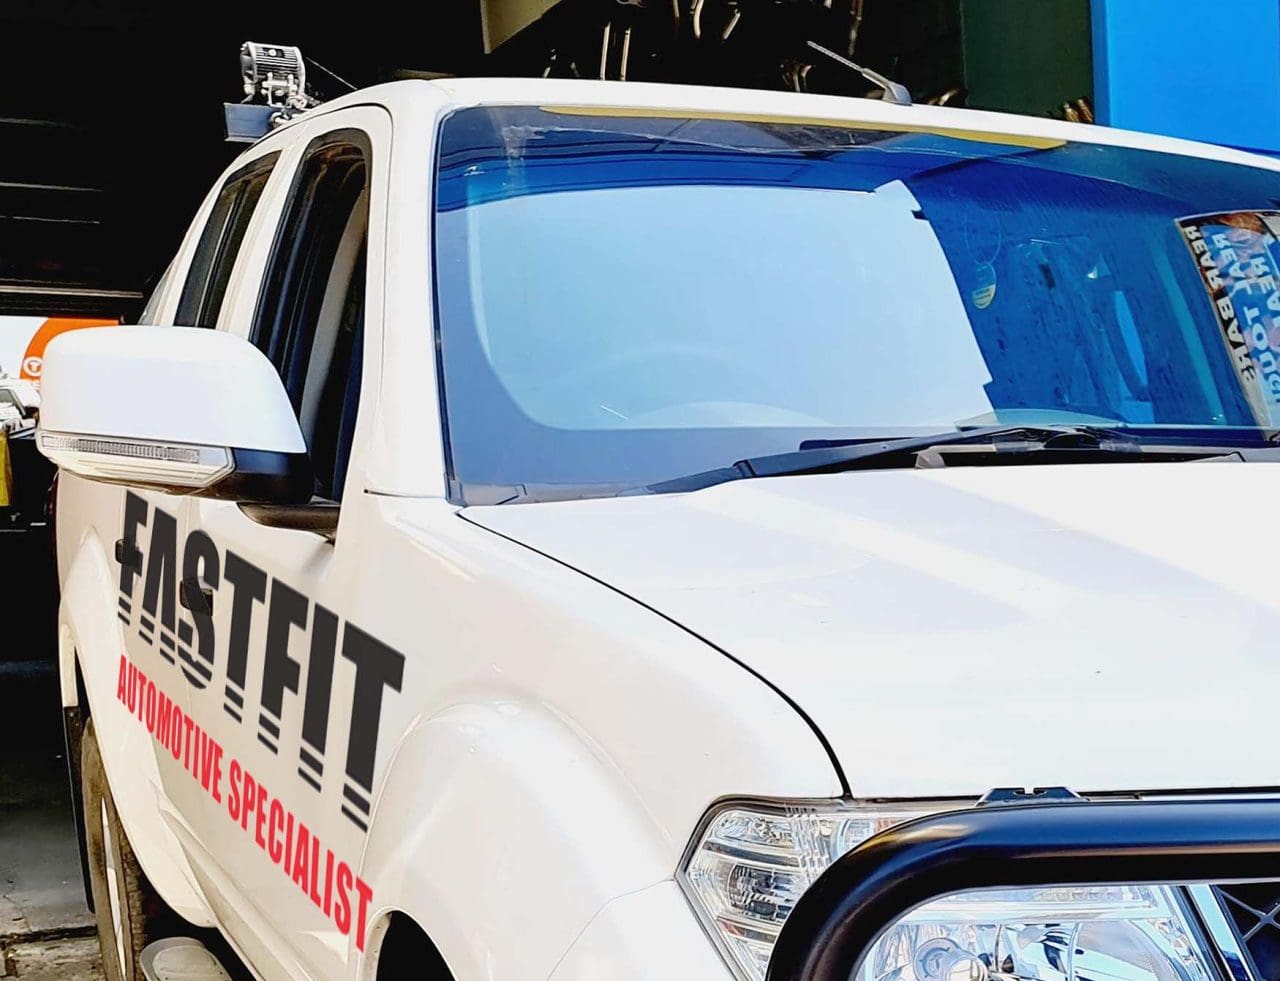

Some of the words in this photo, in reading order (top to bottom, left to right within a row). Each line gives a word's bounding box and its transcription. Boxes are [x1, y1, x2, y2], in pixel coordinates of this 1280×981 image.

[116, 653, 223, 805] AUTOMOTIVE
[227, 757, 374, 953] SPECIALIST
[117, 490, 406, 832] FASTFIT
